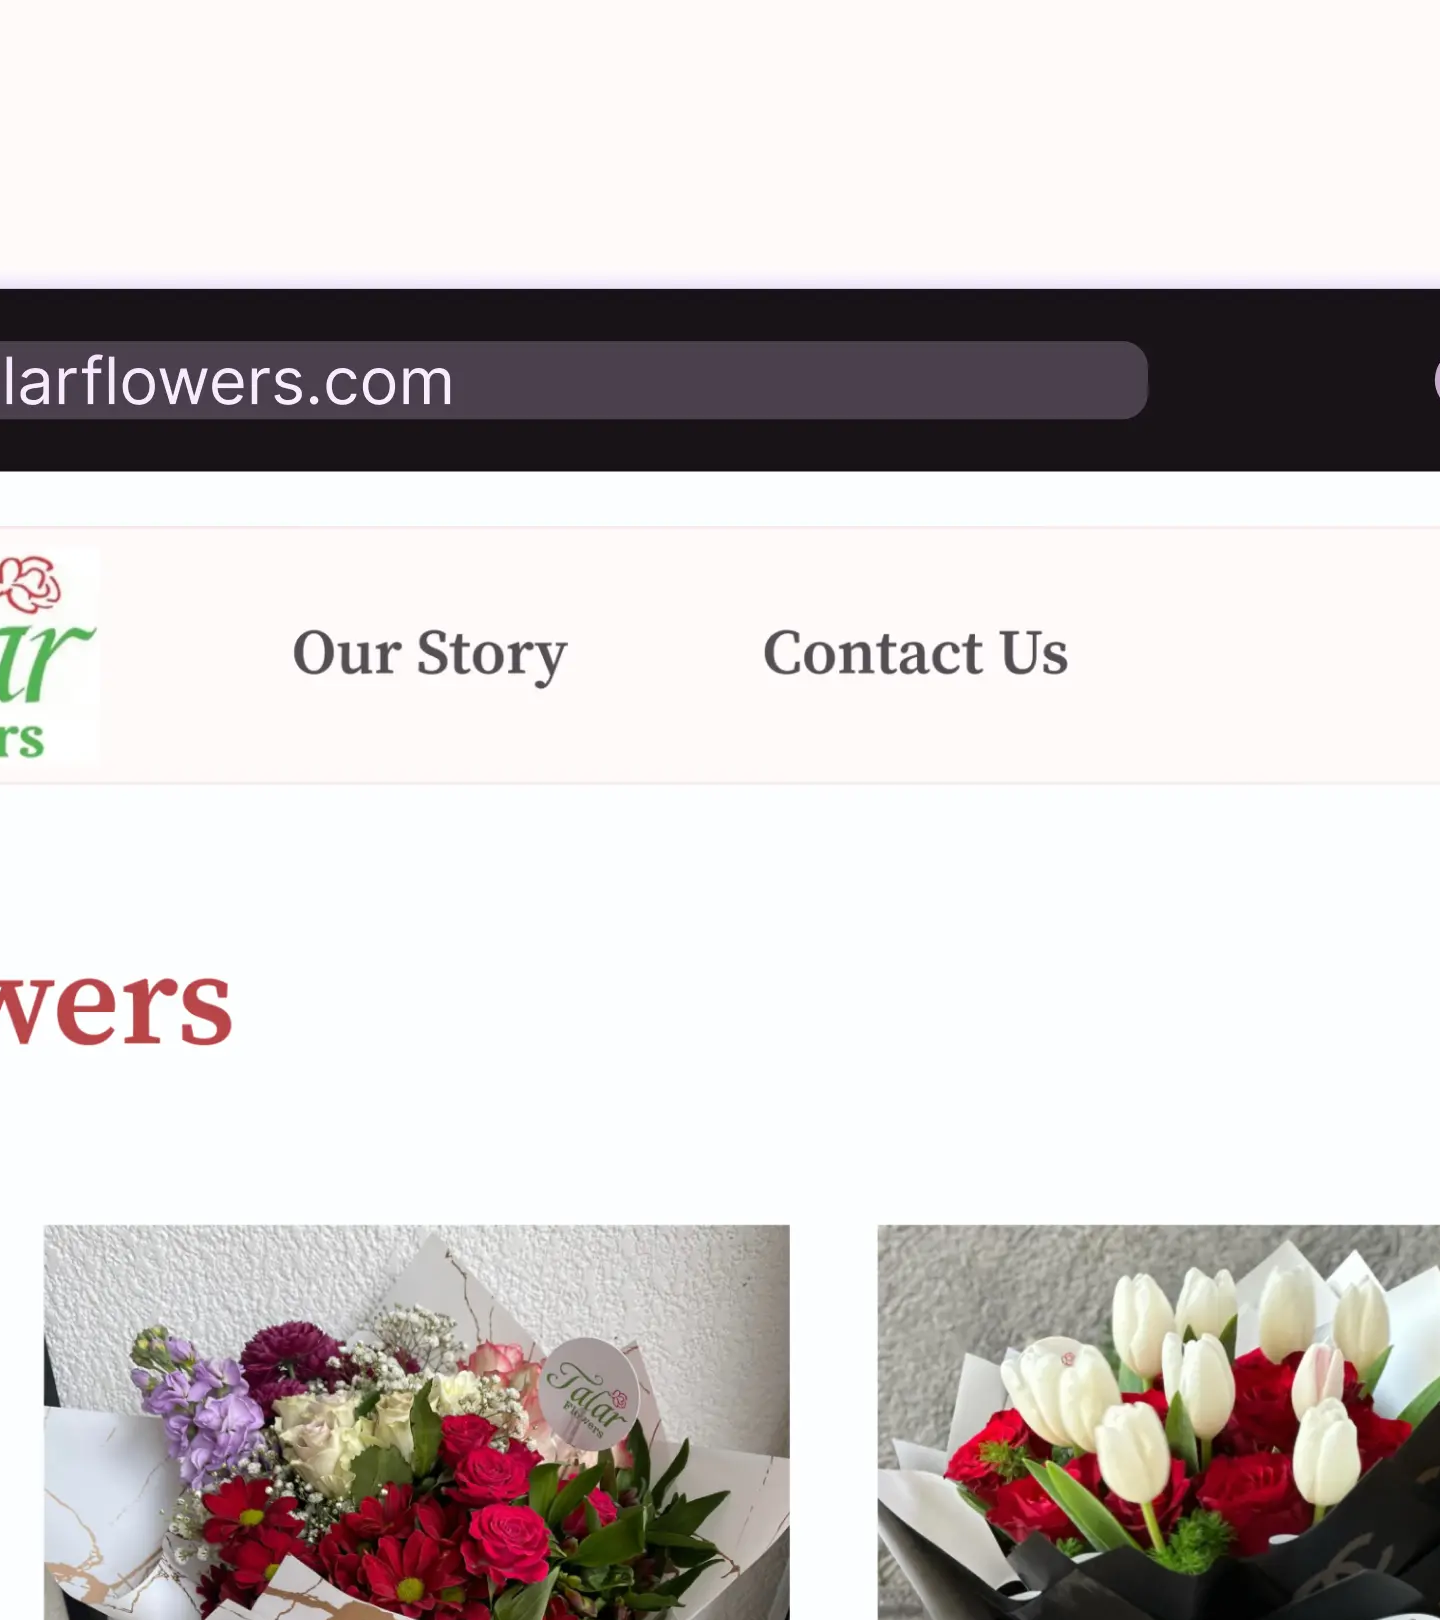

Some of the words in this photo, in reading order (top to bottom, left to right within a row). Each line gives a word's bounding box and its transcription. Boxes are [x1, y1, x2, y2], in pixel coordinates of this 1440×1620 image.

[294, 629, 402, 675] Our
[418, 629, 568, 689] Story
[764, 629, 984, 675] Contact
[999, 630, 1068, 675] Us
[546, 1362, 628, 1428] Talar
